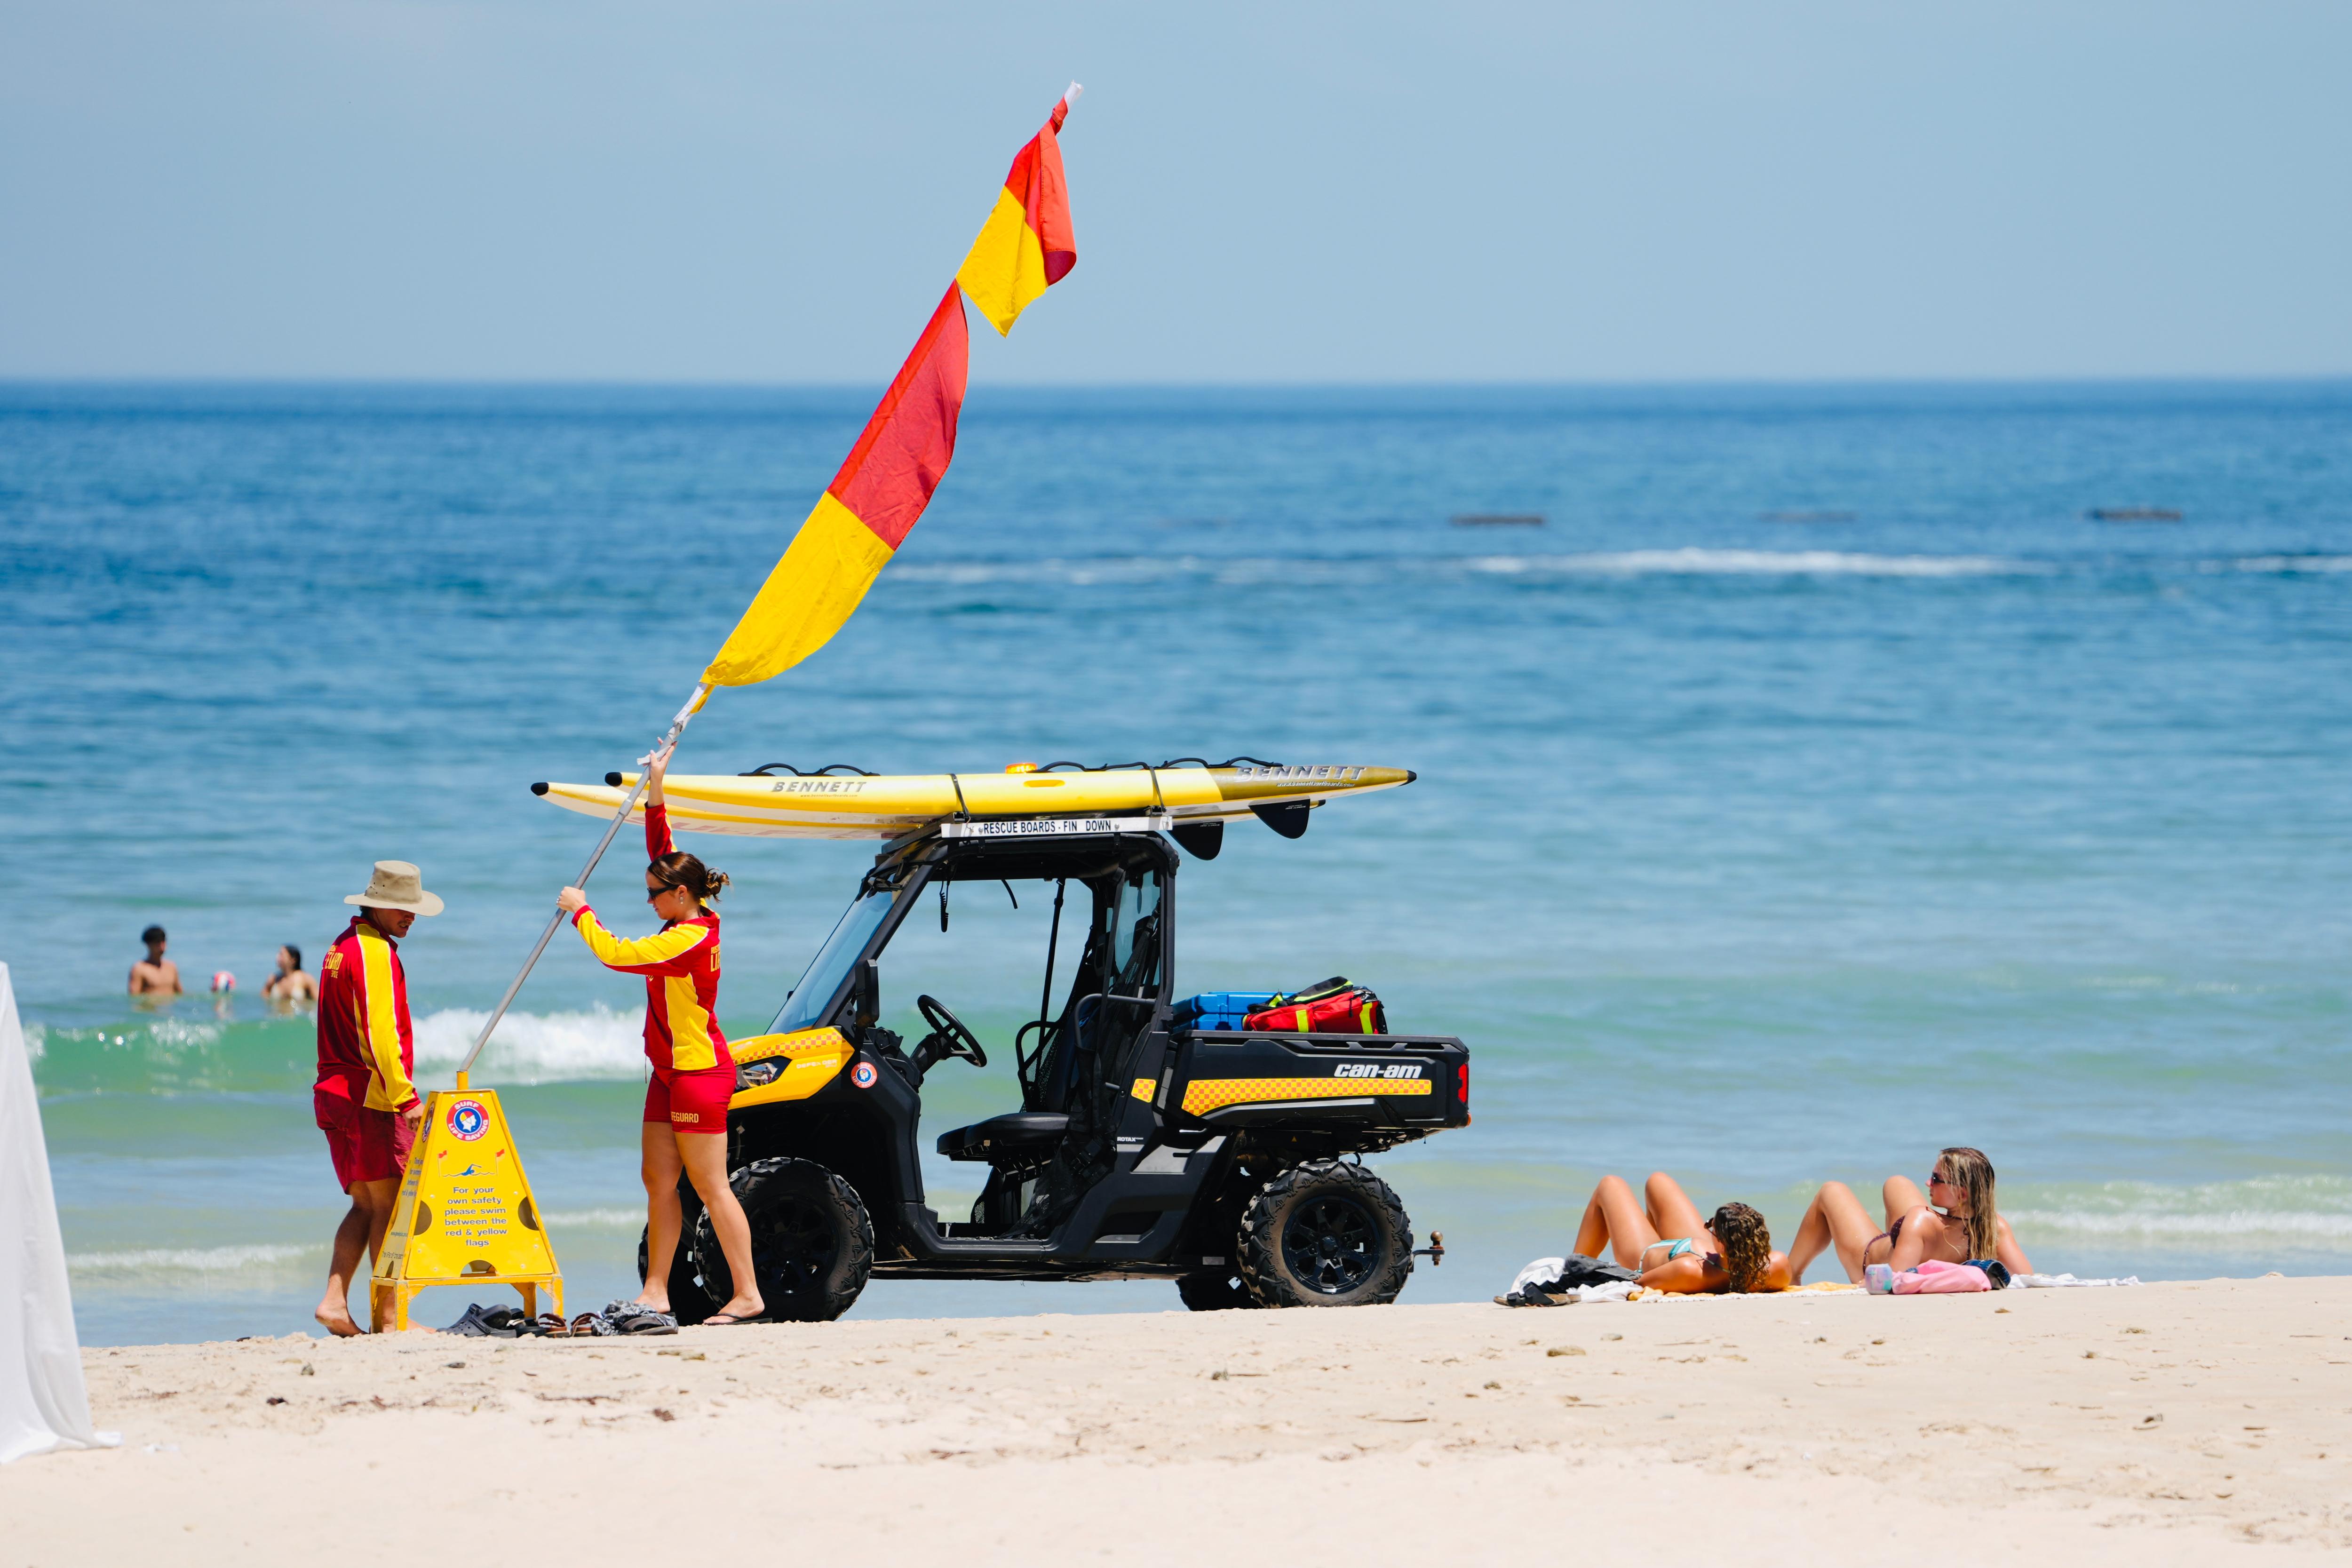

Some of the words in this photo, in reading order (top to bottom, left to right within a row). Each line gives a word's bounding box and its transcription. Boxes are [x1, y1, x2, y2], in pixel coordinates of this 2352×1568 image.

[1233, 766, 1367, 782] BENNETT
[771, 781, 867, 792] BENNETT
[984, 822, 1017, 834] RESCUE
[1021, 821, 1055, 833] BOARDS
[1064, 820, 1077, 832] FIN
[1086, 820, 1111, 831] DOWN
[1334, 1064, 1422, 1079] can-am
[454, 1101, 479, 1110] SURF
[448, 1123, 463, 1138] LIFE
[465, 1120, 489, 1140] SAVING
[445, 1208, 476, 1217] please
[477, 1228, 507, 1236] yellow
